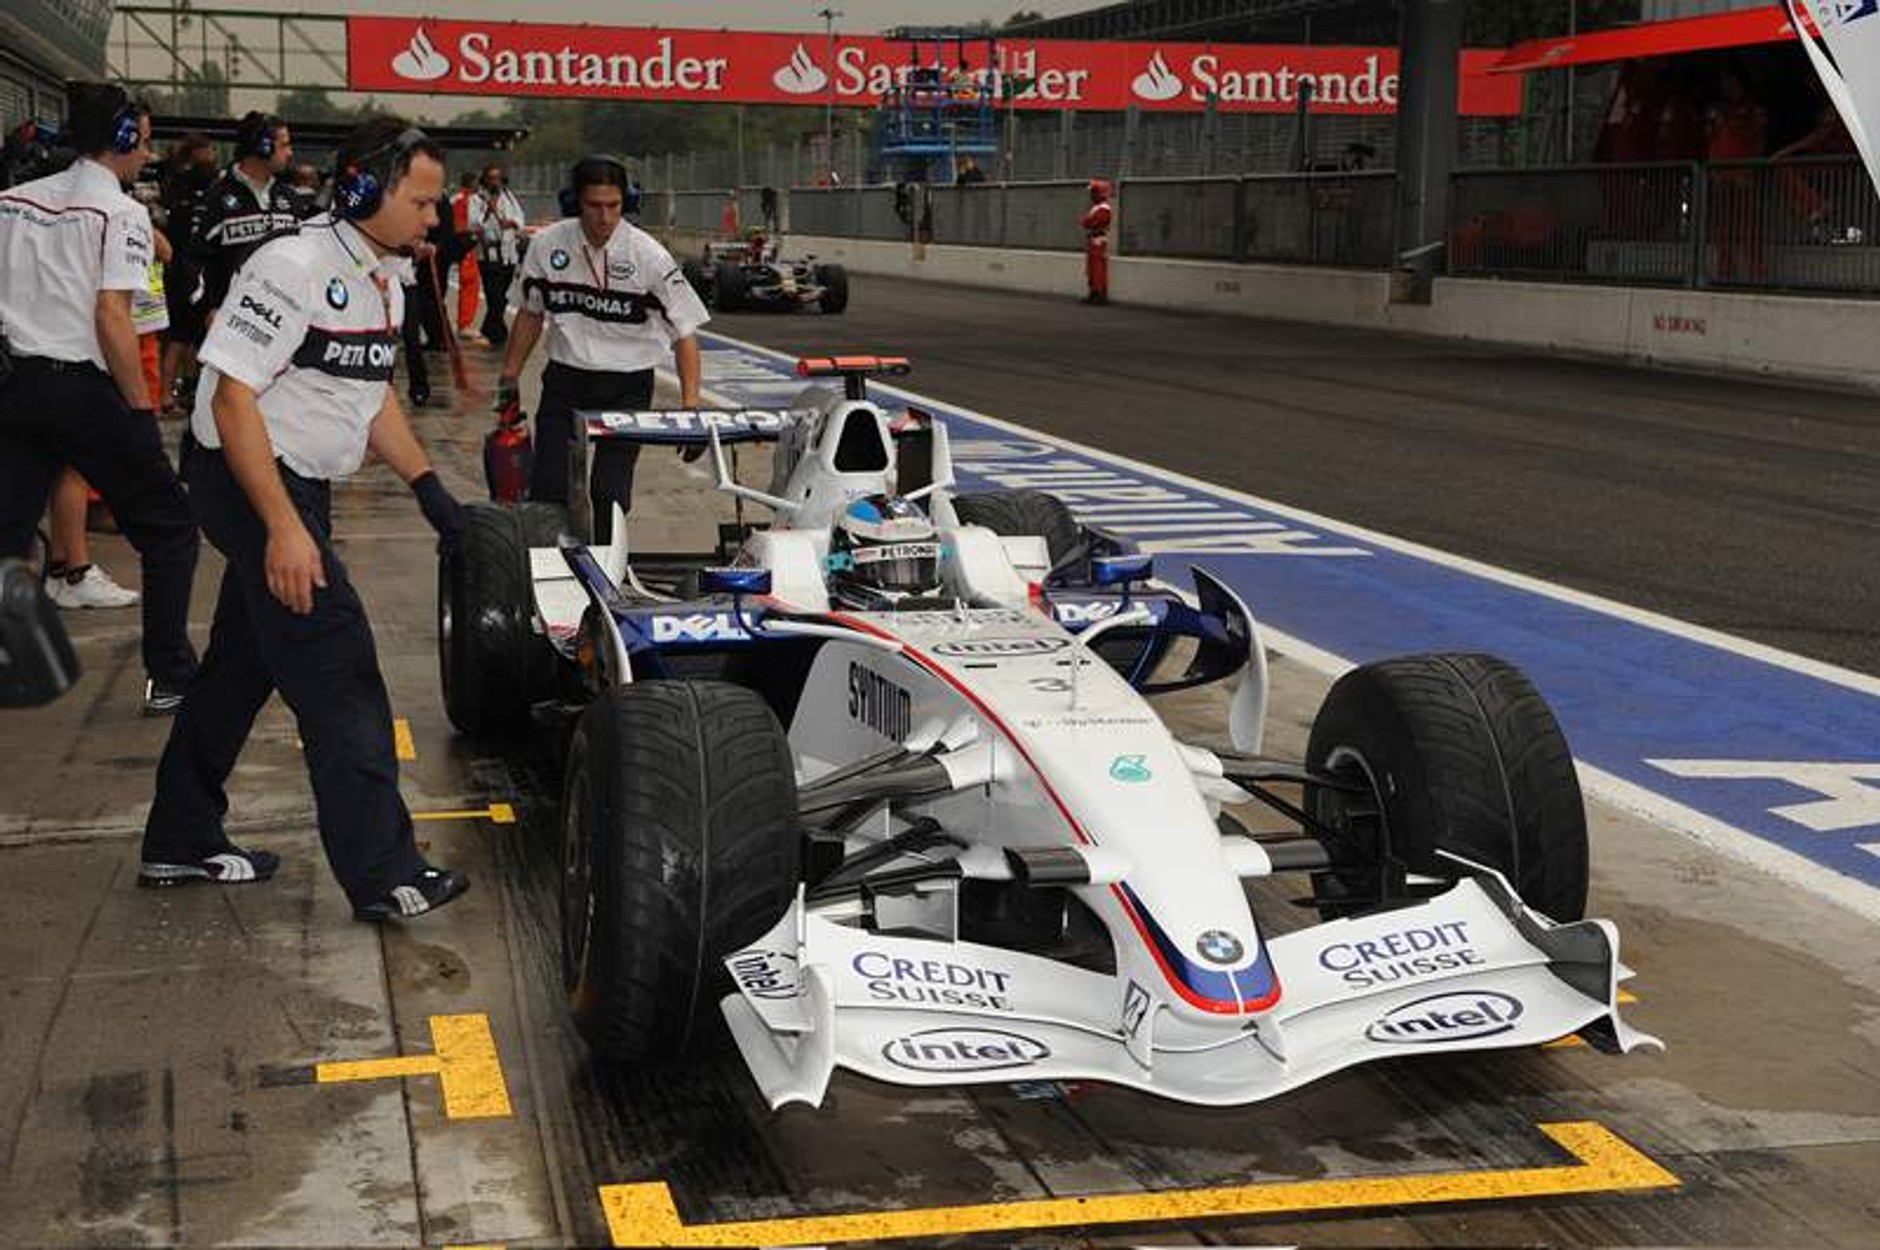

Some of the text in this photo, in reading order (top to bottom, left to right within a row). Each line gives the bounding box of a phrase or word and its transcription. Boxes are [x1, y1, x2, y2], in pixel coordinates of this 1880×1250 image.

[458, 32, 727, 90] Santander
[835, 46, 1088, 101] Sander
[239, 294, 283, 329] DELL
[1319, 920, 1470, 972] CREDIT
[733, 951, 795, 994] intel
[852, 951, 1010, 993] CREDIT
[1343, 948, 1486, 990] SUISSE
[868, 980, 1014, 1012] SUISSE
[1378, 1001, 1504, 1036] intel
[899, 1037, 1028, 1060] intel
